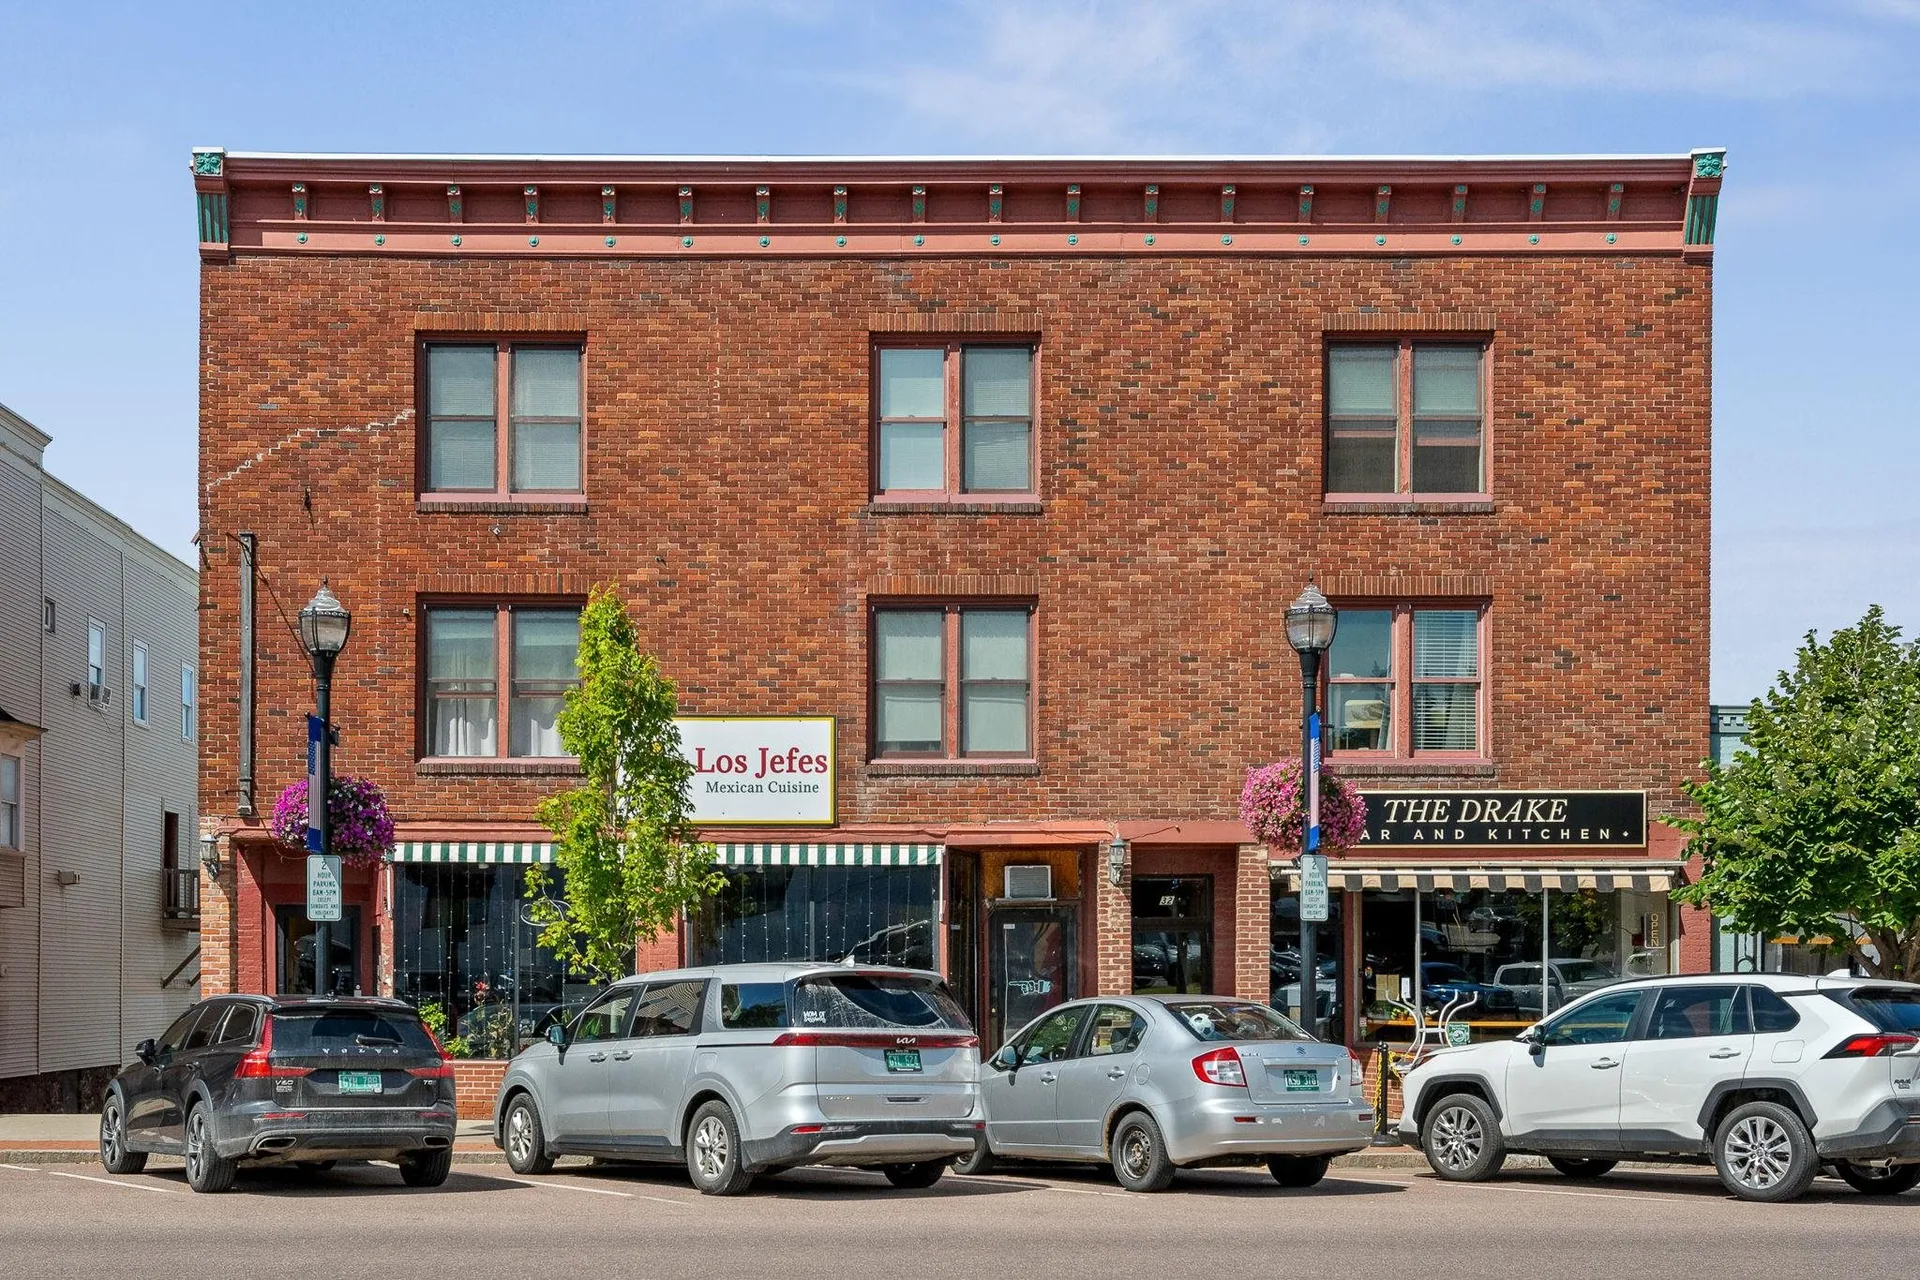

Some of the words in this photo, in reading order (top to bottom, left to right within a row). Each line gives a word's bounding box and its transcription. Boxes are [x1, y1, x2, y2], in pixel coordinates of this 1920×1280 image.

[695, 747, 748, 774] Los
[755, 746, 828, 779] Jefes
[705, 781, 764, 794] Mexican
[768, 781, 819, 794] Cuisine
[1384, 799, 1451, 823] THE
[1456, 798, 1568, 823] DRAKE
[1360, 829, 1391, 840] AR
[1413, 829, 1465, 840] AND
[1488, 828, 1610, 840] KITCHEN
[321, 861, 327, 870] 2
[1312, 860, 1317, 870] 2
[1160, 896, 1174, 905] 32
[1650, 913, 1660, 947] OPEN
